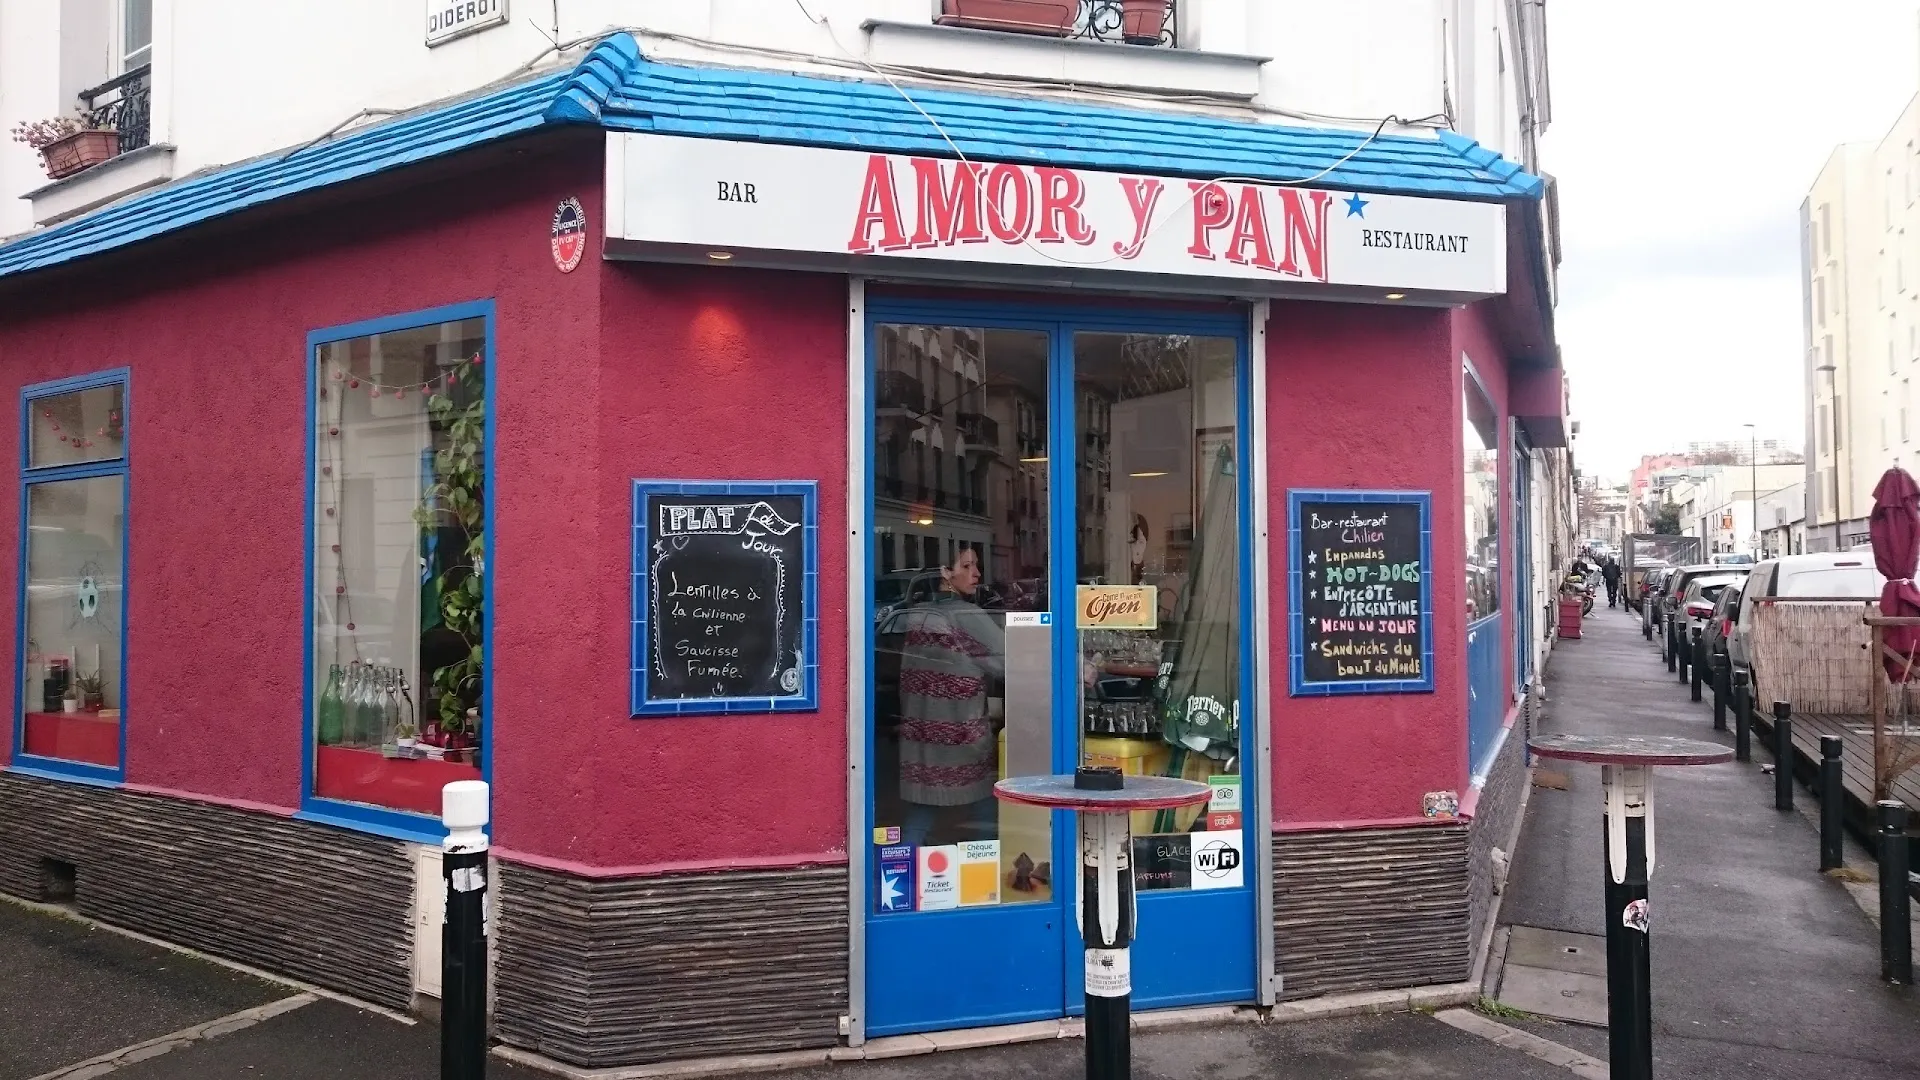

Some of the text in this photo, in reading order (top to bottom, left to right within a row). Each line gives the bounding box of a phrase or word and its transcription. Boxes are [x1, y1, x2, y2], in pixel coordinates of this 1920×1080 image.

[717, 181, 758, 204] BAR
[848, 154, 1096, 254] AMOR
[1187, 182, 1332, 283] PAN
[1362, 229, 1468, 254] RESTAURANT
[670, 507, 735, 531] PLAT
[742, 529, 783, 555] Jour
[1341, 527, 1385, 543] Chilien
[1086, 596, 1141, 622] Open
[1378, 620, 1416, 634] JOUR
[675, 639, 739, 657] Saucisse
